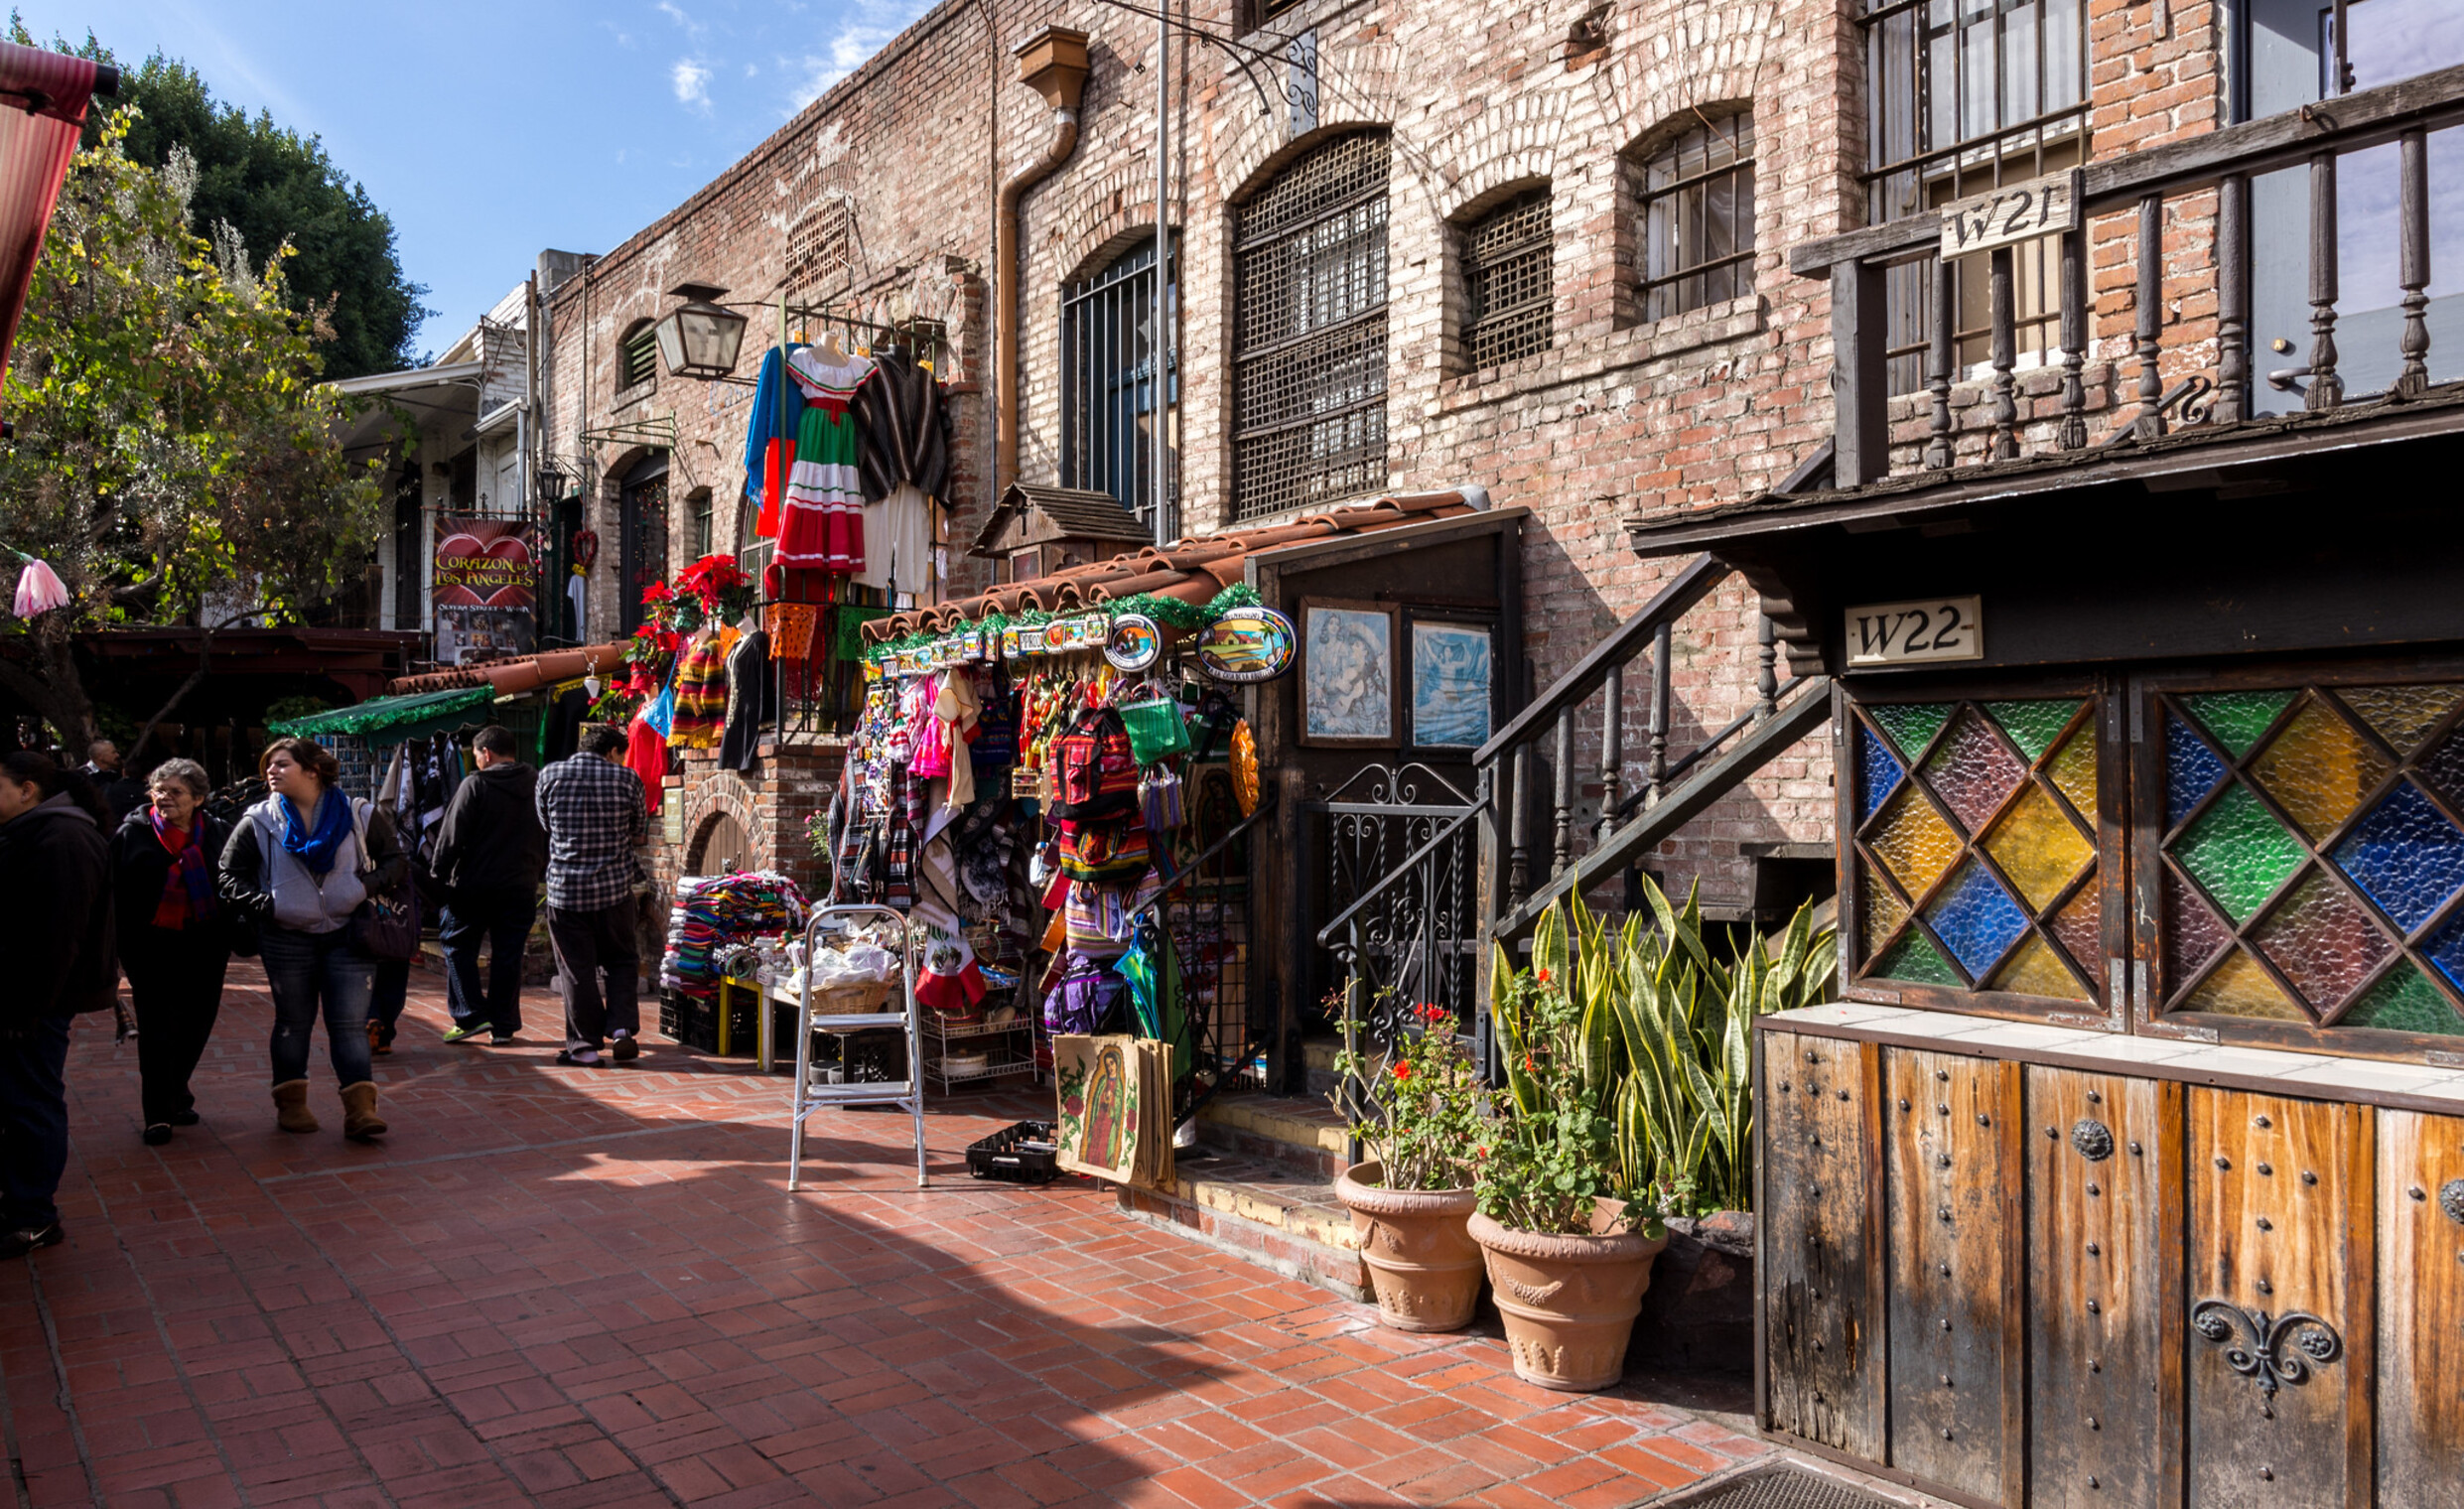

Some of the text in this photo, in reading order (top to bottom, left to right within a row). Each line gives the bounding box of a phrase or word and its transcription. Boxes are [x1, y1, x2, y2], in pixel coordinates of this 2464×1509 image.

[435, 554, 516, 572] CORAZON
[436, 570, 534, 587] LOS ANGELES
[1856, 605, 1962, 654] W22
